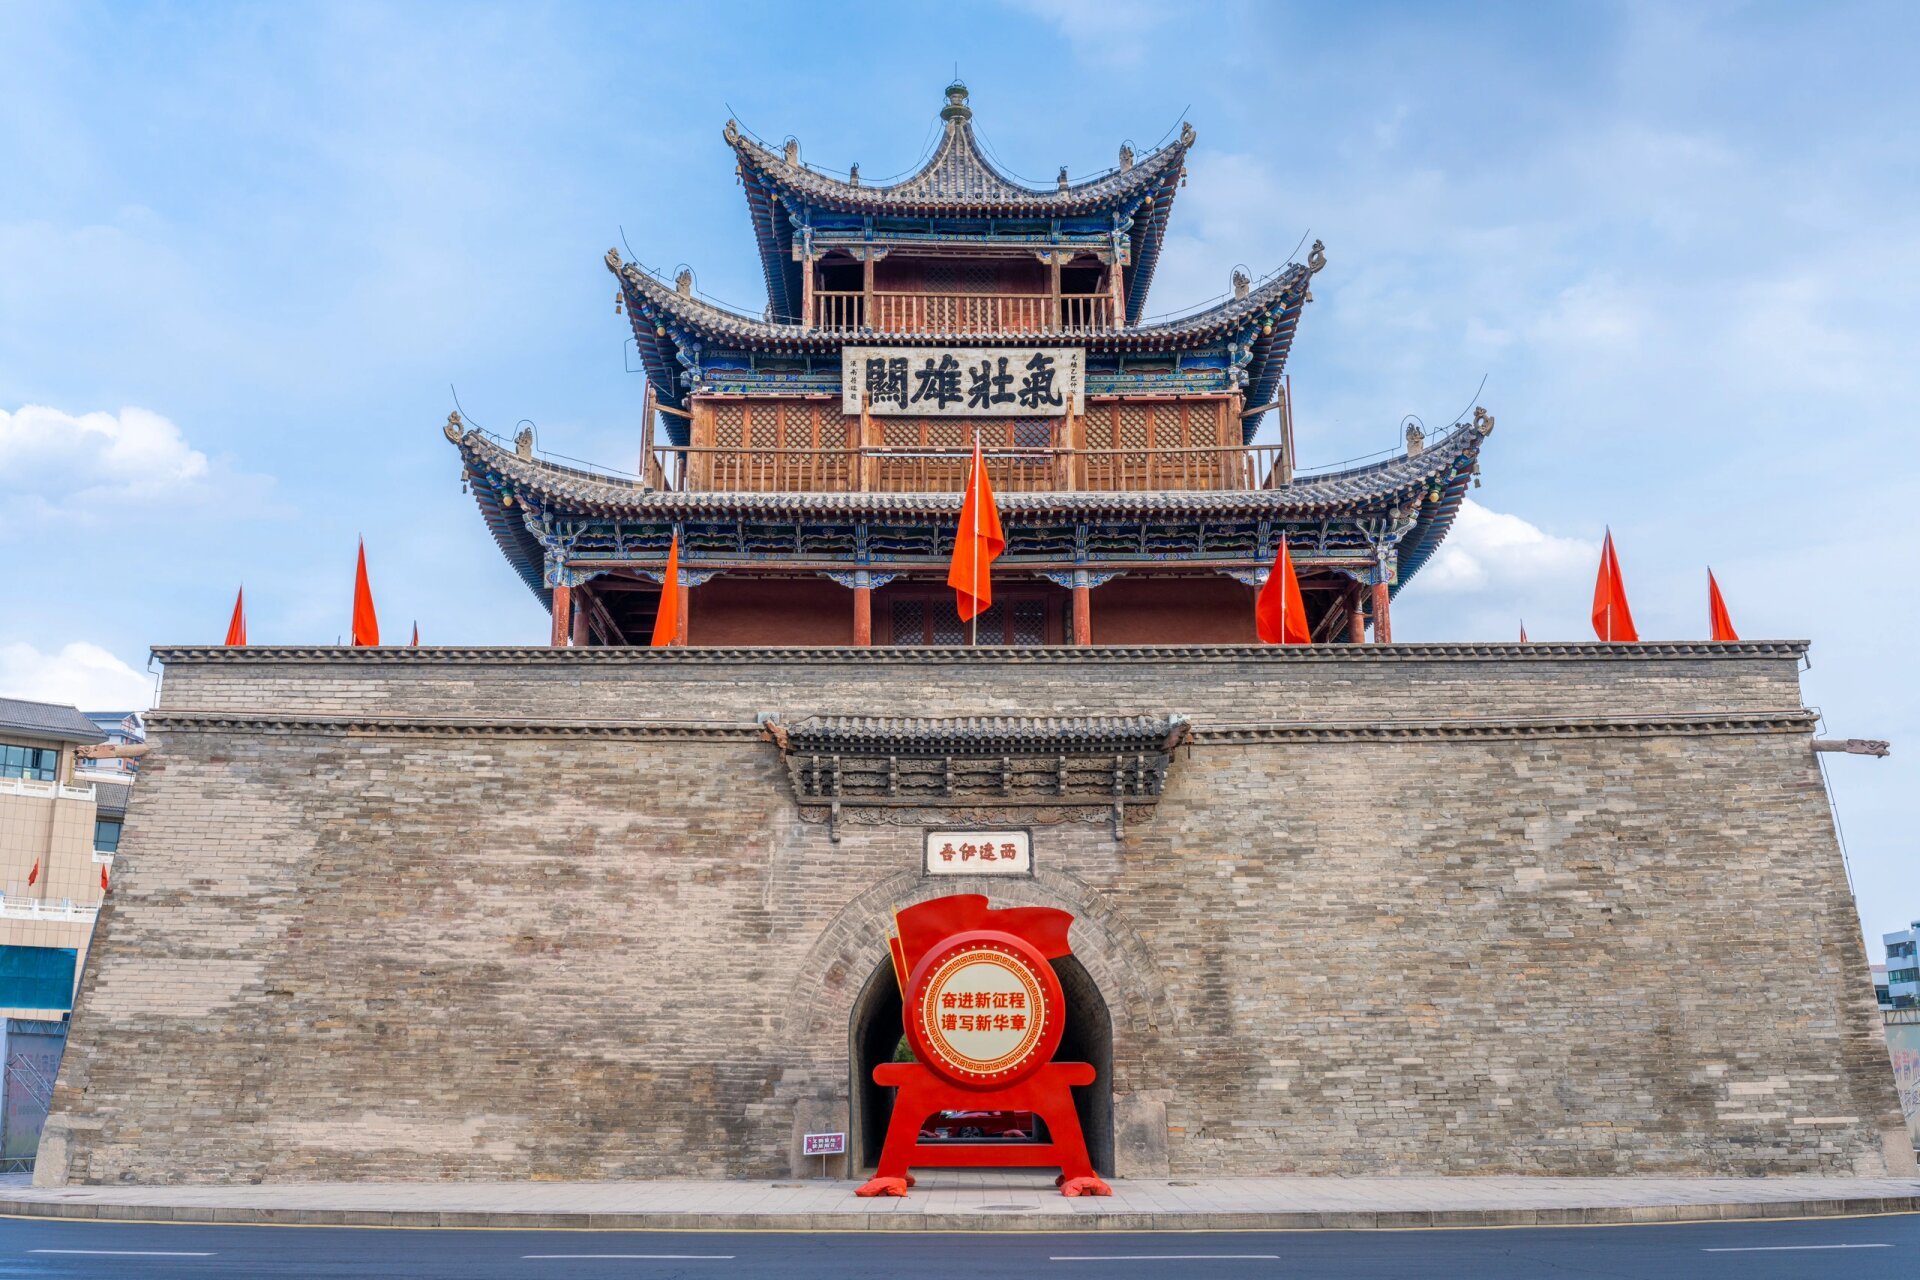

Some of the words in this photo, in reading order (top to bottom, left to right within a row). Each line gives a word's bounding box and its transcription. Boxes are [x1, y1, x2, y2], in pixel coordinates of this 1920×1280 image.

[941, 992, 1026, 1009] 奋进新征程
[941, 1014, 1027, 1032] 谱写新华章
